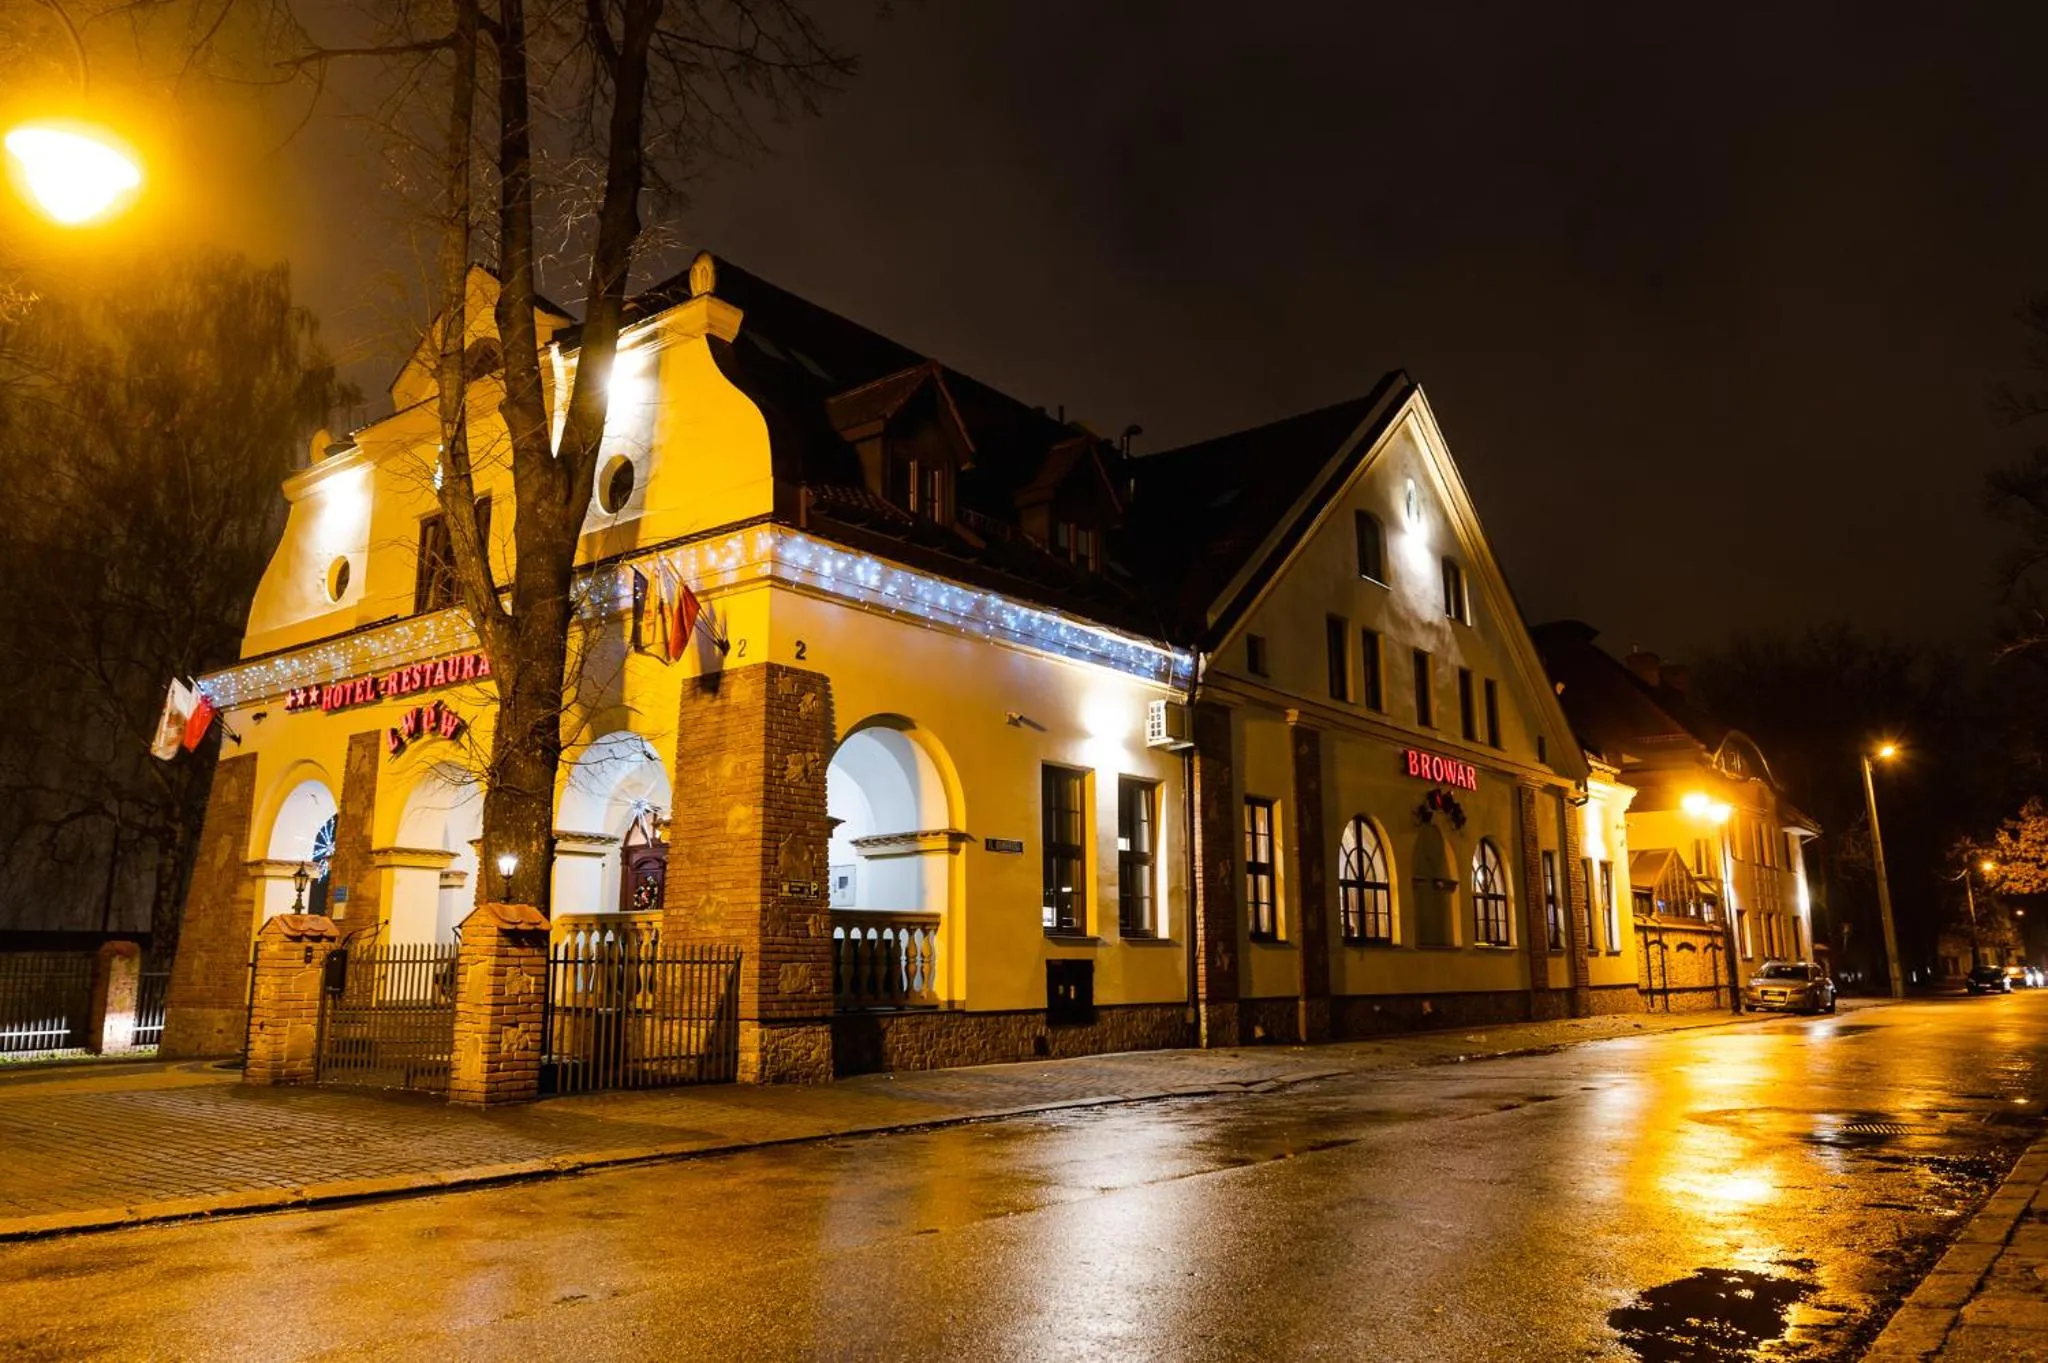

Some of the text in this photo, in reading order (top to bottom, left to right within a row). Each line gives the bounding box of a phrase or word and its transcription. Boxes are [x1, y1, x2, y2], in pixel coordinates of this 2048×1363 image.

[738, 638, 748, 658] 2
[795, 639, 807, 660] 2
[1407, 749, 1478, 791] BROWAR
